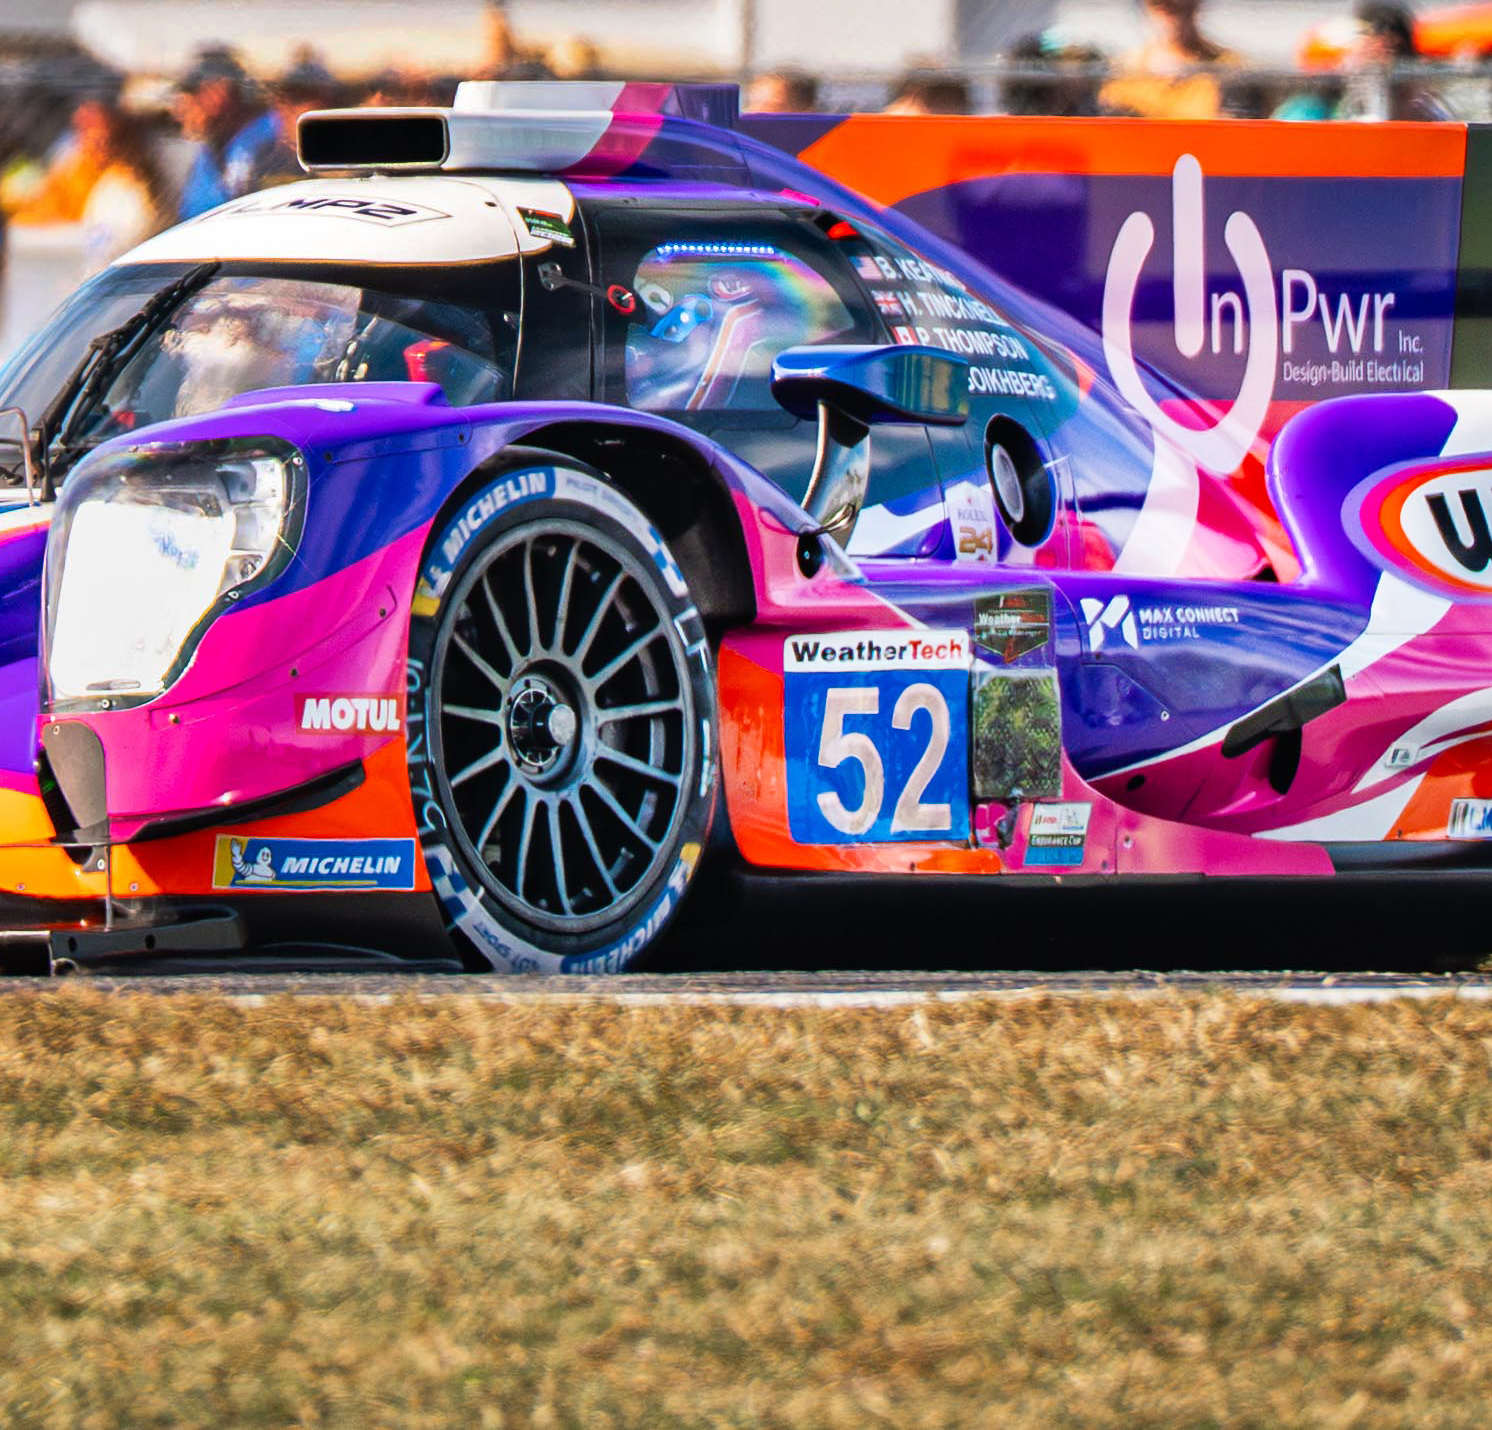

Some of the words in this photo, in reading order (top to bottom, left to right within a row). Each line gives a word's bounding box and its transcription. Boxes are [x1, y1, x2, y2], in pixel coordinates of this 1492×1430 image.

[874, 255, 902, 280] B.
[896, 289, 923, 316] H.
[933, 327, 1030, 361] THOMPSON
[1399, 329, 1424, 354] Inc.
[1366, 360, 1425, 383] Electrical
[442, 471, 548, 565] MICHELIN
[958, 526, 994, 555] 24
[1138, 608, 1173, 624] MAX
[1176, 607, 1240, 623] CONNECT
[1142, 625, 1200, 640] DIGITAL
[791, 639, 963, 663] WeatherTech
[301, 697, 401, 731] MOTUL
[816, 682, 953, 836] 52
[280, 856, 402, 875] MICHELIN
